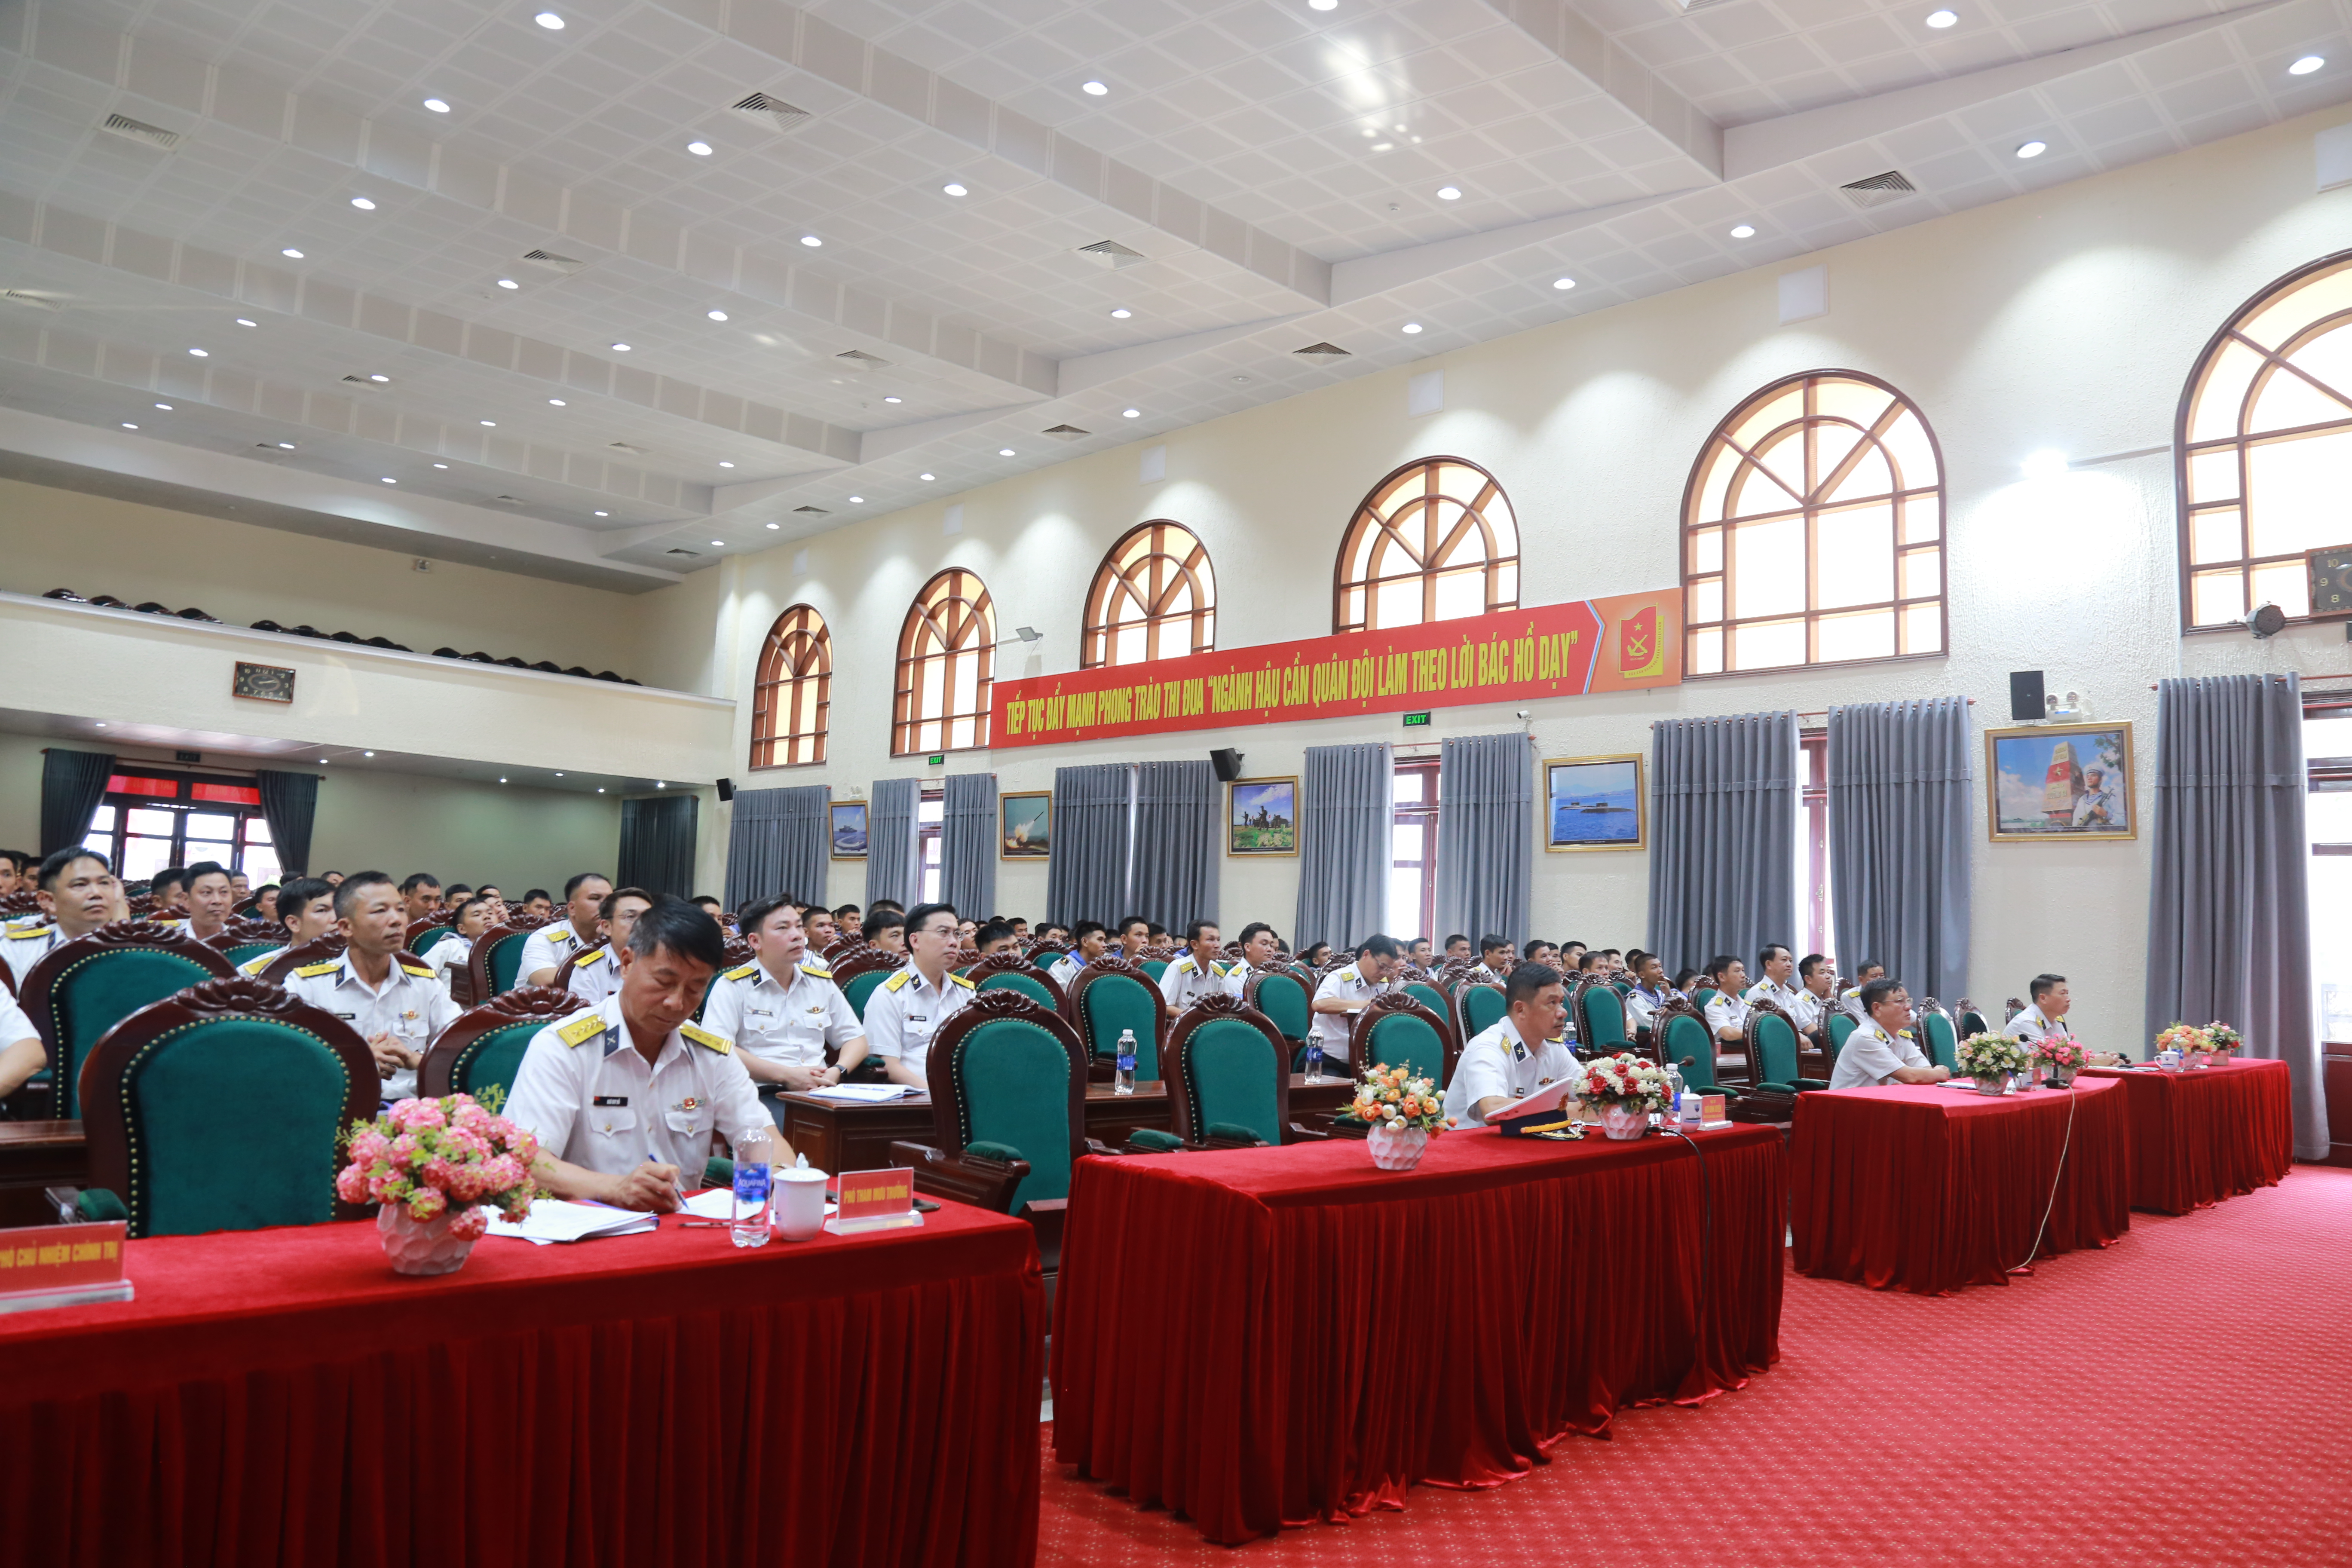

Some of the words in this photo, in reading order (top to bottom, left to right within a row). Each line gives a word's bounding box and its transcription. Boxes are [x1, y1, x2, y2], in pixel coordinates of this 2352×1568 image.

[2328, 559, 2339, 567] 10
[2320, 578, 2328, 586] 9
[2331, 594, 2339, 603] 8
[1007, 690, 1026, 735] TIẾP
[1028, 698, 1045, 740] TỤC
[1046, 682, 1065, 731] ĐẨY
[1066, 692, 1096, 735] MẠNH
[1097, 686, 1132, 726] PHONG
[1135, 677, 1161, 721] TRÀO
[1164, 680, 1181, 718] THI
[1182, 678, 1204, 717] ĐUA
[1208, 665, 1253, 714] “NGÀNH
[1255, 661, 1280, 717] HẬU
[1283, 652, 1310, 707] CẦN
[1313, 652, 1349, 708] QUÂN
[1351, 648, 1375, 708] ĐỘI
[1378, 645, 1408, 697] LÀM
[1412, 647, 1447, 693] THEO
[1451, 634, 1474, 689] LỜI
[1478, 631, 1509, 686] BÁC
[1513, 621, 1535, 683] HỒ
[1539, 630, 1578, 689] DẠY”
[1406, 714, 1427, 724] EXIT
[738, 1178, 766, 1188] AQUAFINA
[844, 1187, 855, 1204] PHÓ
